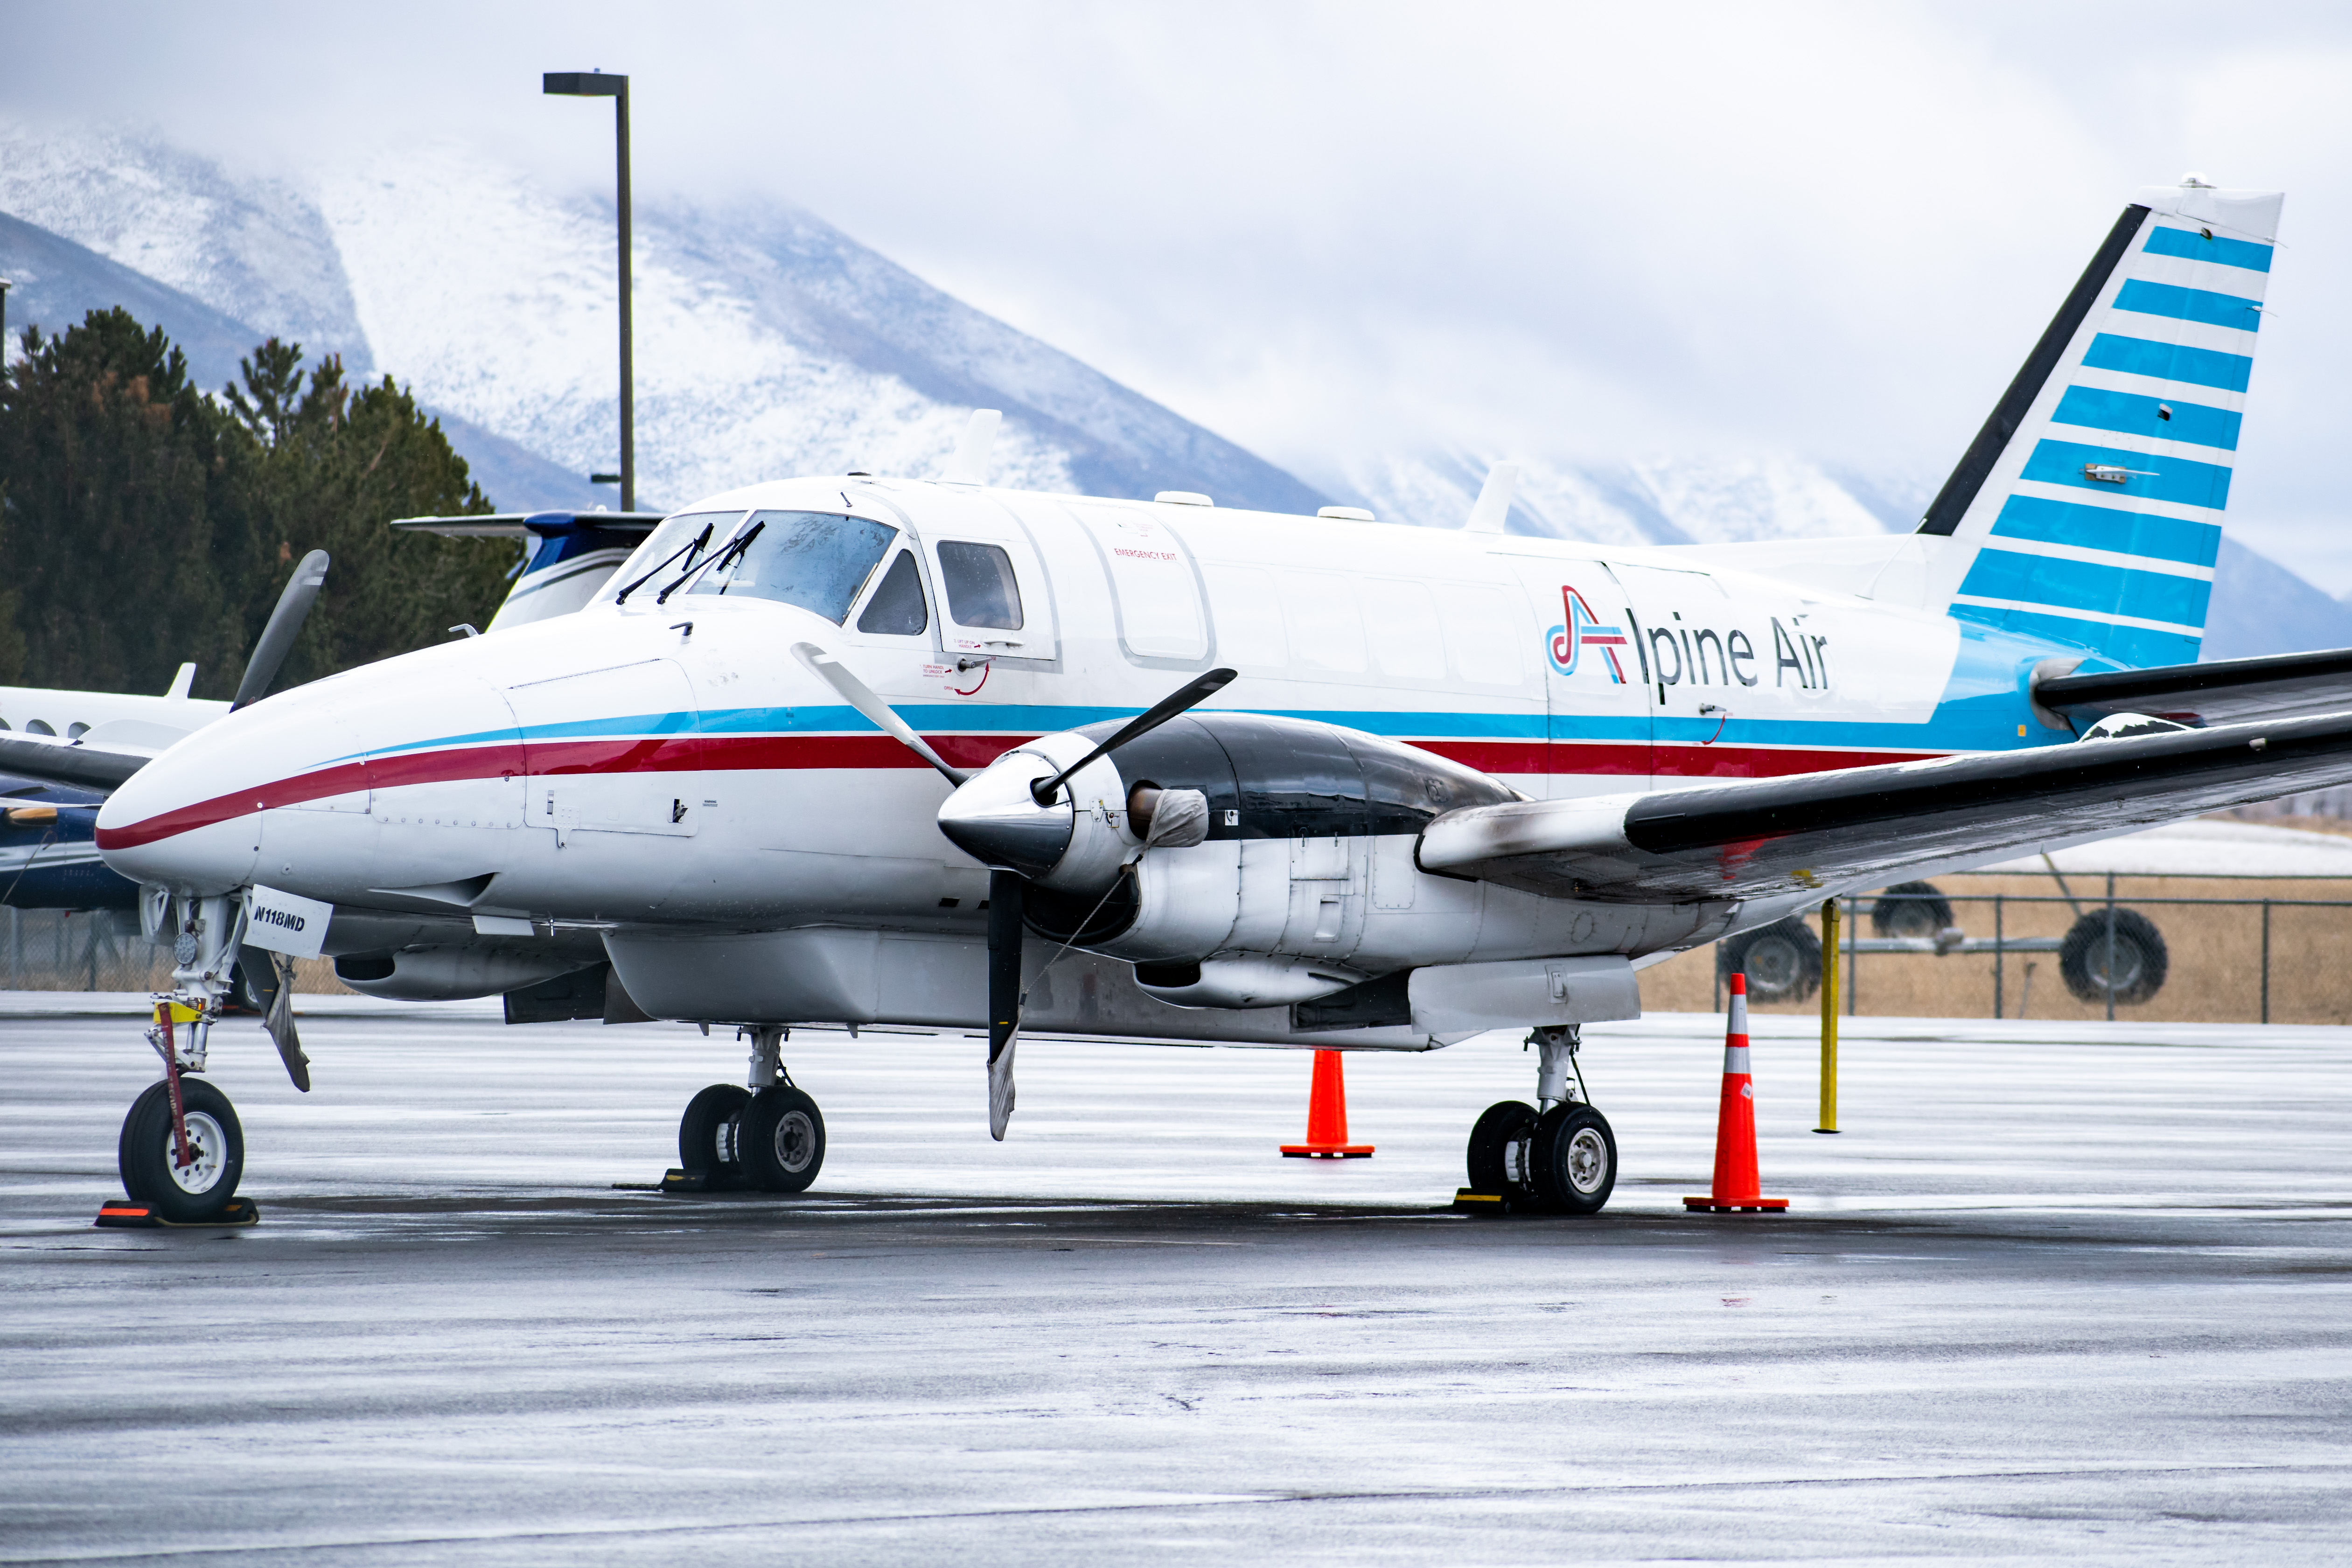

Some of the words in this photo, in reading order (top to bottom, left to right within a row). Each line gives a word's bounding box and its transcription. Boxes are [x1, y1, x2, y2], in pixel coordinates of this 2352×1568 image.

[1114, 548, 1160, 559] EMERGENCY
[1545, 585, 1759, 705] Alpine
[1771, 616, 1829, 690] Air
[254, 906, 305, 932] N118MD
